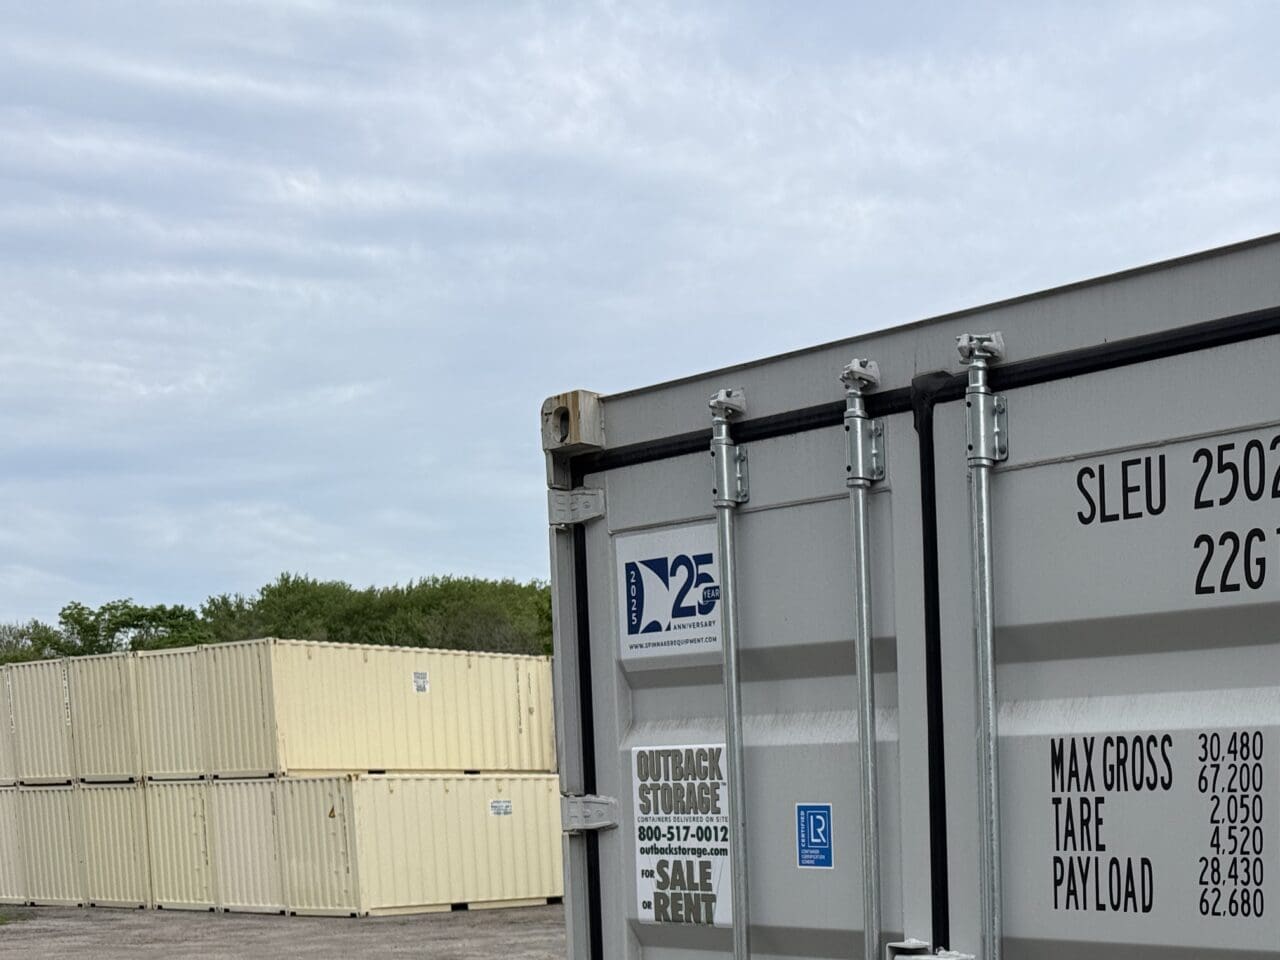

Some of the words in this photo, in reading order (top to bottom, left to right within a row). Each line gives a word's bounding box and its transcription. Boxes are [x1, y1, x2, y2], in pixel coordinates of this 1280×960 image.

[1076, 454, 1167, 525] SLEU
[630, 571, 638, 625] 2025
[669, 552, 717, 619] 25
[673, 620, 716, 631] ANNIVERSARY
[636, 747, 723, 782] OUTBACK
[1050, 736, 1096, 792] MAX
[1102, 734, 1173, 792] GROSS
[1198, 731, 1264, 763] 30,480
[1198, 763, 1263, 794] 67,200
[638, 825, 729, 842] 800-517-0012
[1052, 796, 1106, 852] TARE
[1210, 794, 1263, 825] 2,050
[640, 843, 729, 858] outbackstorage.com
[1210, 825, 1264, 856] 4,520
[641, 868, 655, 879] FOR
[656, 859, 713, 892] SALE
[1053, 856, 1154, 913] PAYLOAD
[1198, 857, 1264, 887] 28,430
[642, 901, 652, 910] OR
[653, 891, 717, 924] RENT
[1199, 888, 1264, 918] 62,680
